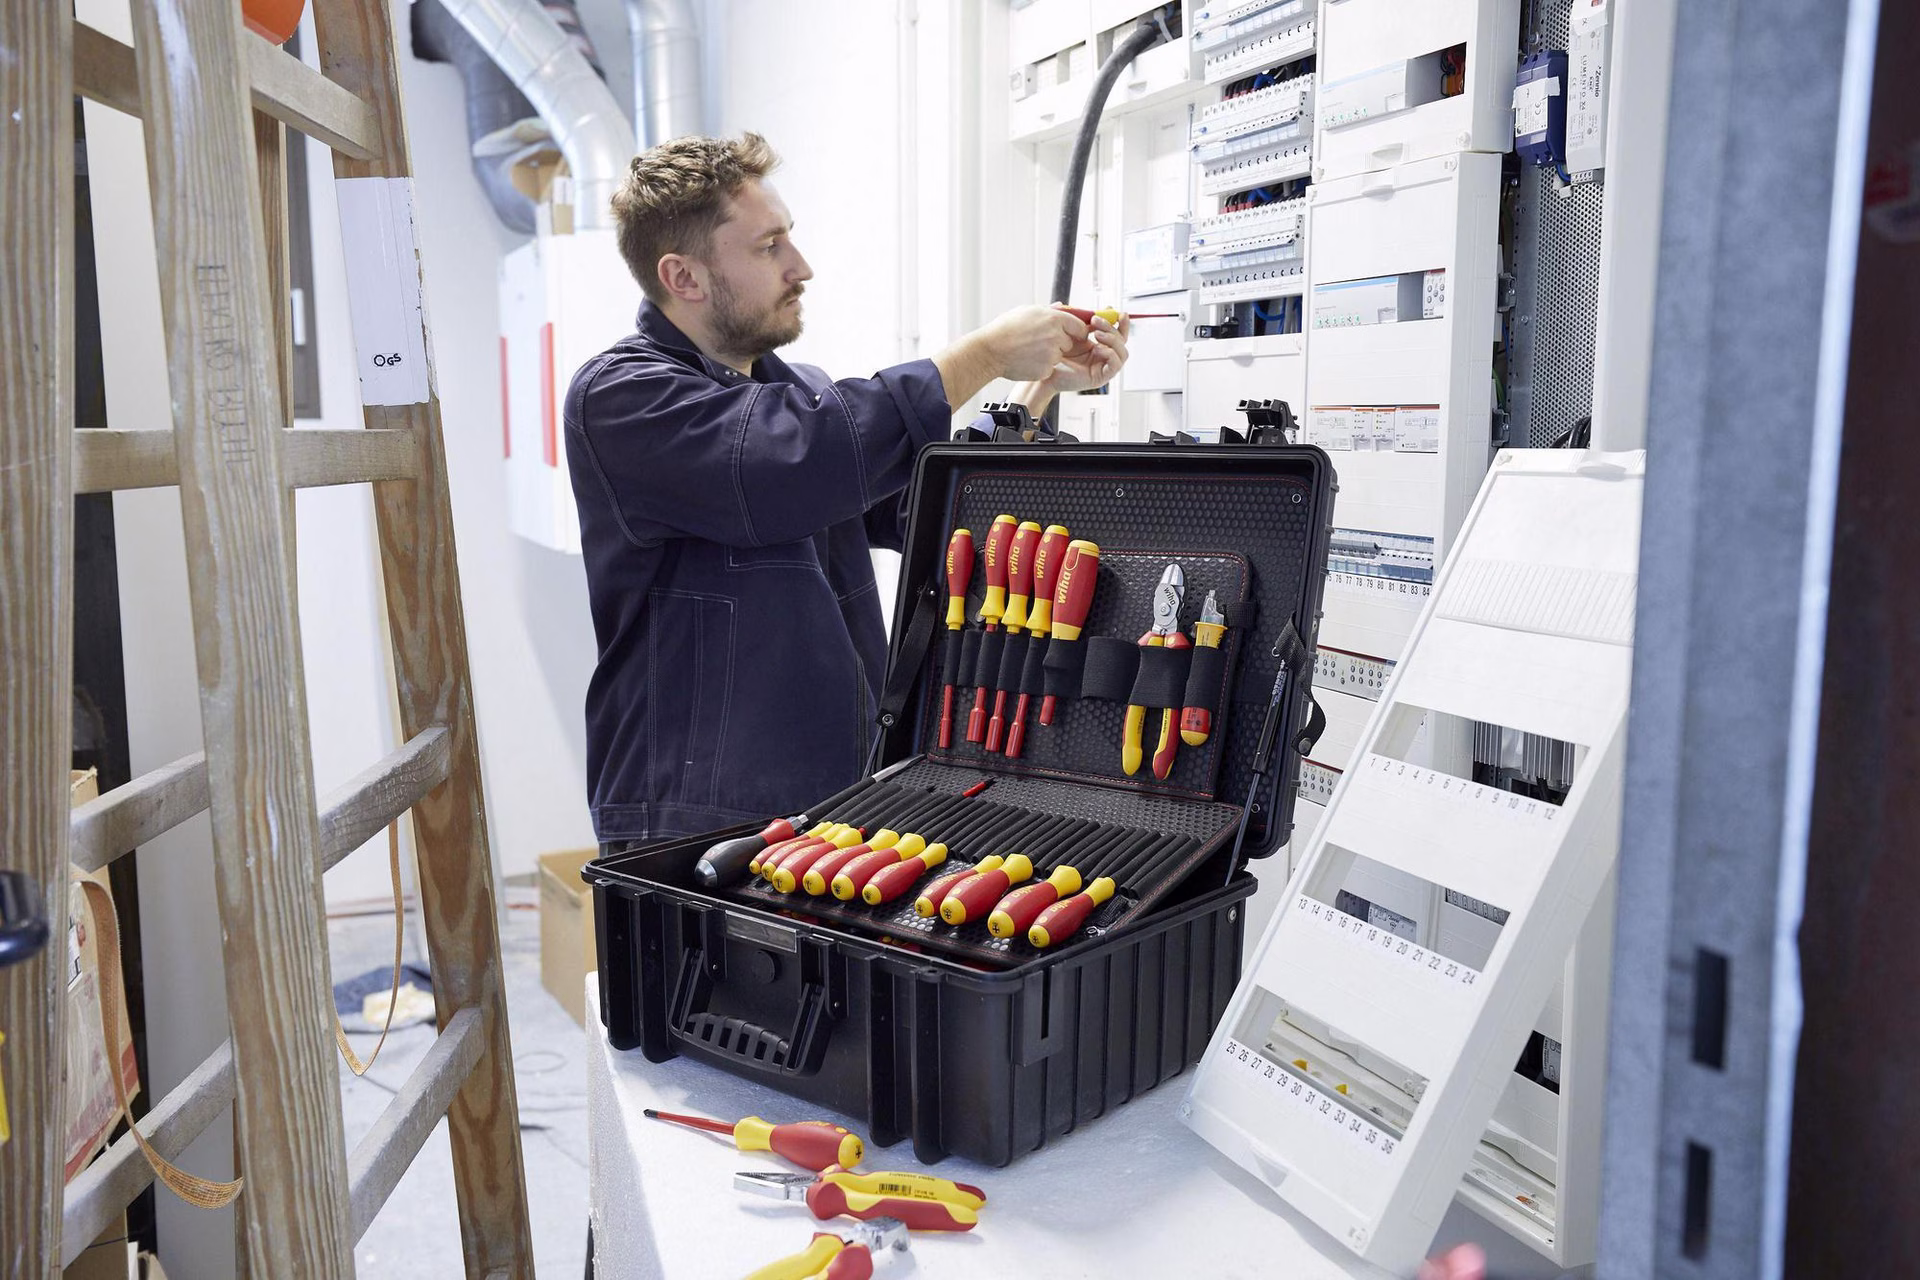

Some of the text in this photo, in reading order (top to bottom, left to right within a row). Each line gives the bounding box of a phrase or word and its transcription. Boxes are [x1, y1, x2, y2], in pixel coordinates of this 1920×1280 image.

[987, 538, 997, 567] wiha
[1010, 546, 1020, 575] wiha
[1035, 550, 1046, 579] wiha
[1058, 570, 1072, 604] wiha
[1164, 587, 1176, 606] wiha
[1336, 574, 1342, 583] 76
[1346, 576, 1352, 584] 77
[1356, 578, 1362, 586] 78
[1367, 579, 1373, 588] 79
[1377, 581, 1384, 589] 80
[1388, 582, 1394, 591] 81
[1400, 584, 1406, 593] 82
[1411, 586, 1418, 595] 83
[1422, 587, 1430, 596] 84
[1370, 759, 1555, 820] 1 2 3 4 5 6 7 8 9 10 11 12
[1298, 899, 1475, 984] 13 14 15 16 17 18 19 20 21 22 23 24
[1226, 1042, 1395, 1154] 25 26 27 28 29 30 31 32 33 34 35 36
